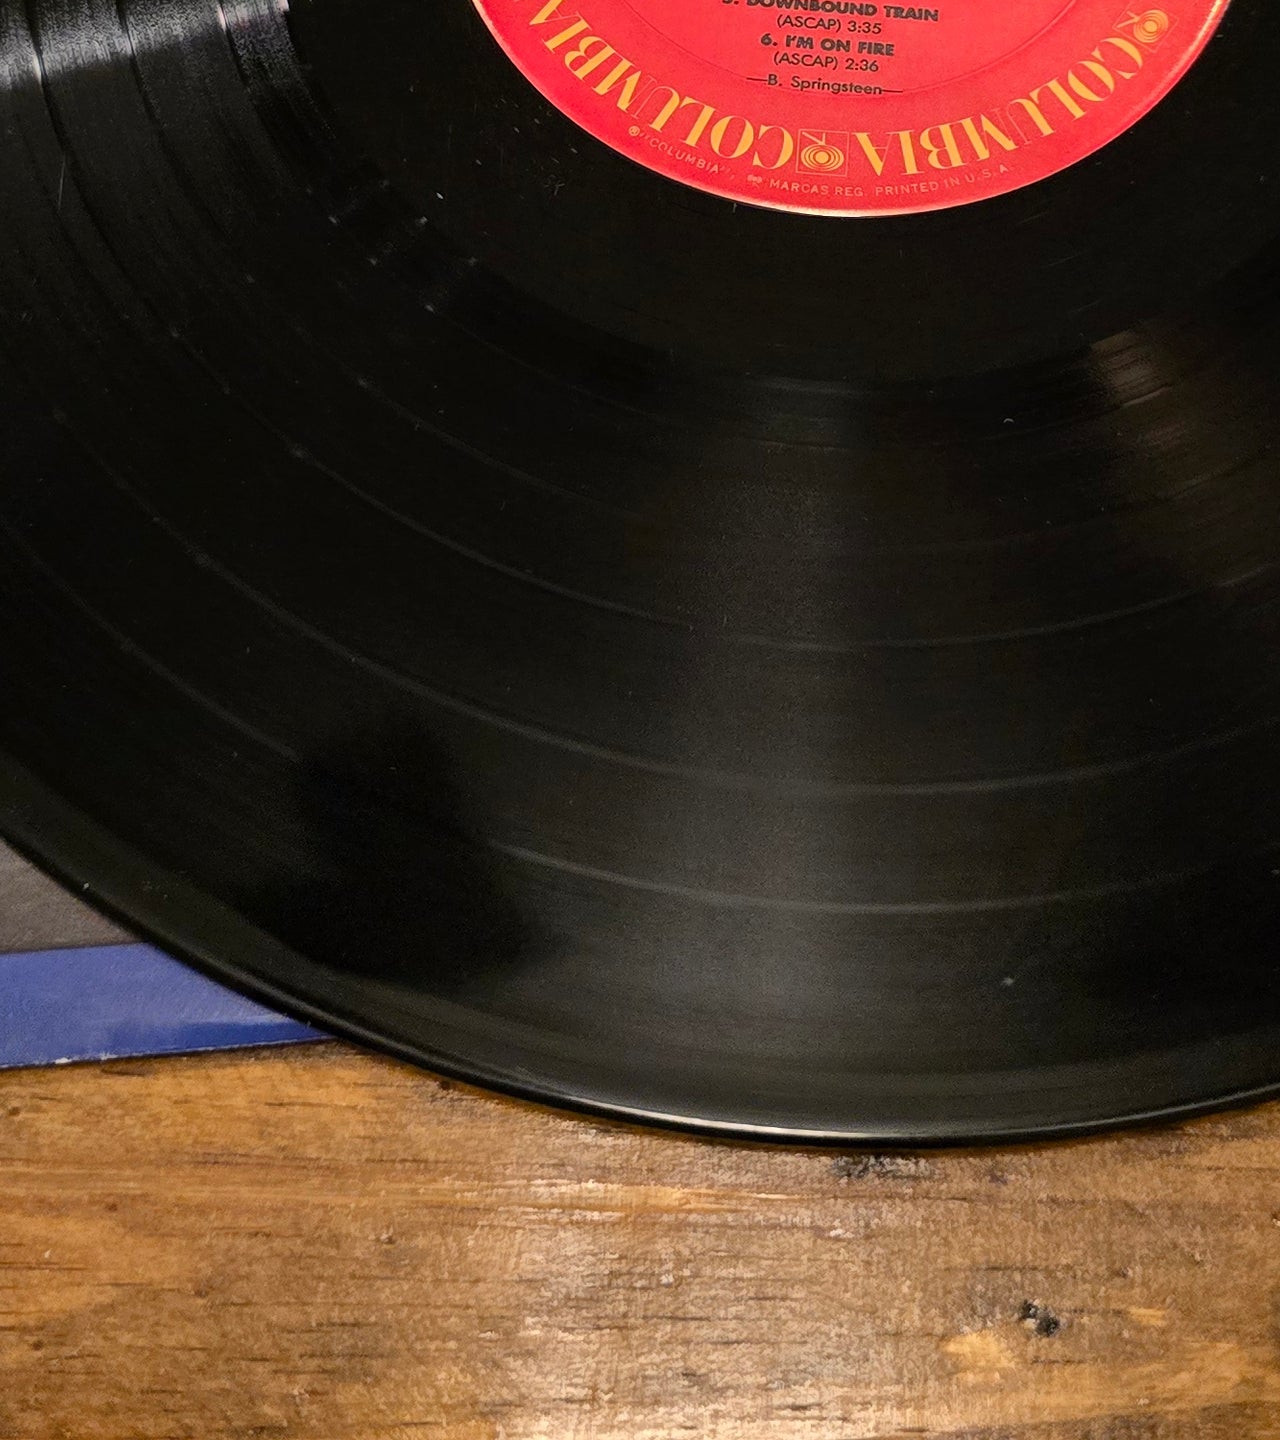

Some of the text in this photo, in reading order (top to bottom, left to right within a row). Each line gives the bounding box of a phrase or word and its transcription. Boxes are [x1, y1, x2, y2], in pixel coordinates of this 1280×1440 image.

[884, 6, 938, 21] TRAIN
[777, 15, 881, 34] (ASCAP) 3:35
[761, 33, 894, 56] 6. I'M ON FIRE
[773, 52, 878, 72] (ASCAP) 2:36
[855, 36, 1143, 177] COLUMBIA
[770, 178, 829, 196] MARCAS
[875, 180, 940, 197] PRINTED
[943, 175, 961, 189] IN
